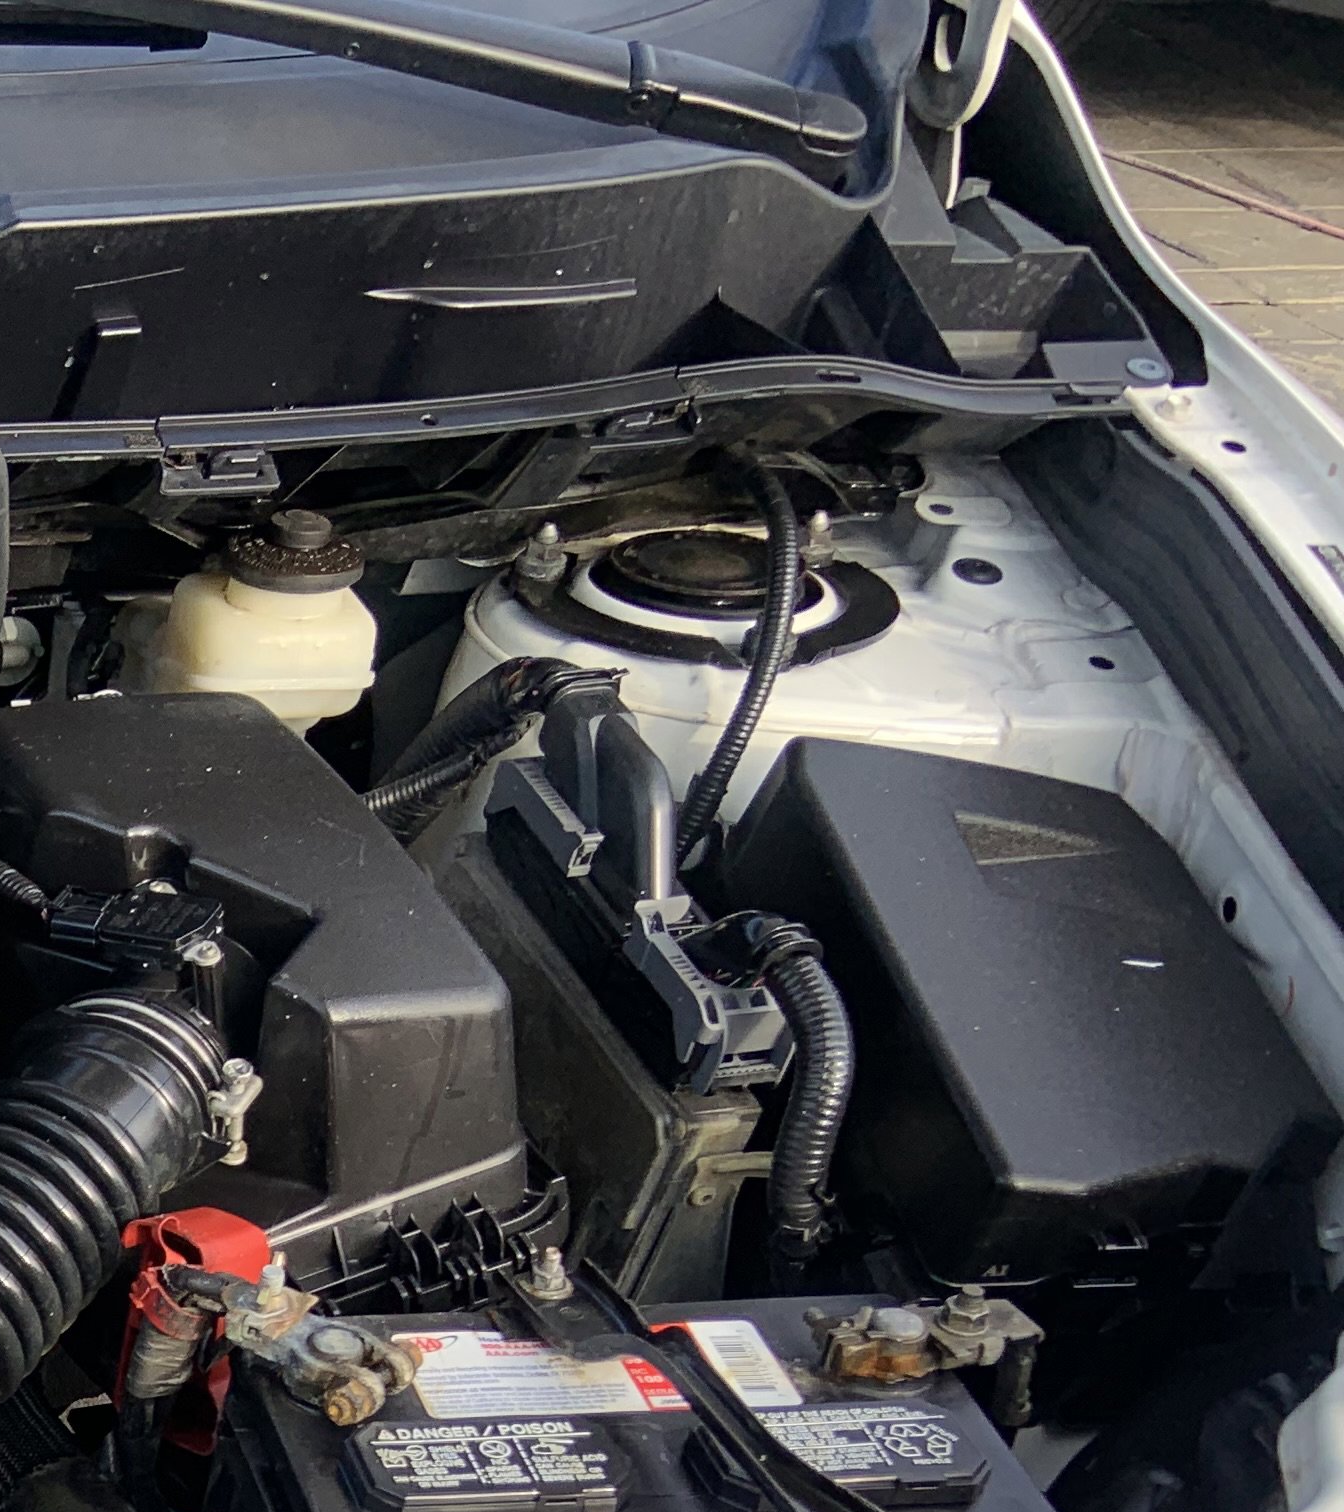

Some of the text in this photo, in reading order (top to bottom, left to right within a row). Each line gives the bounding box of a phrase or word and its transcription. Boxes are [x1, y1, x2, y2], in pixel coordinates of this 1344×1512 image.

[636, 1375, 663, 1384] 100
[396, 1425, 478, 1440] DANGER
[499, 1422, 574, 1436] POISON
